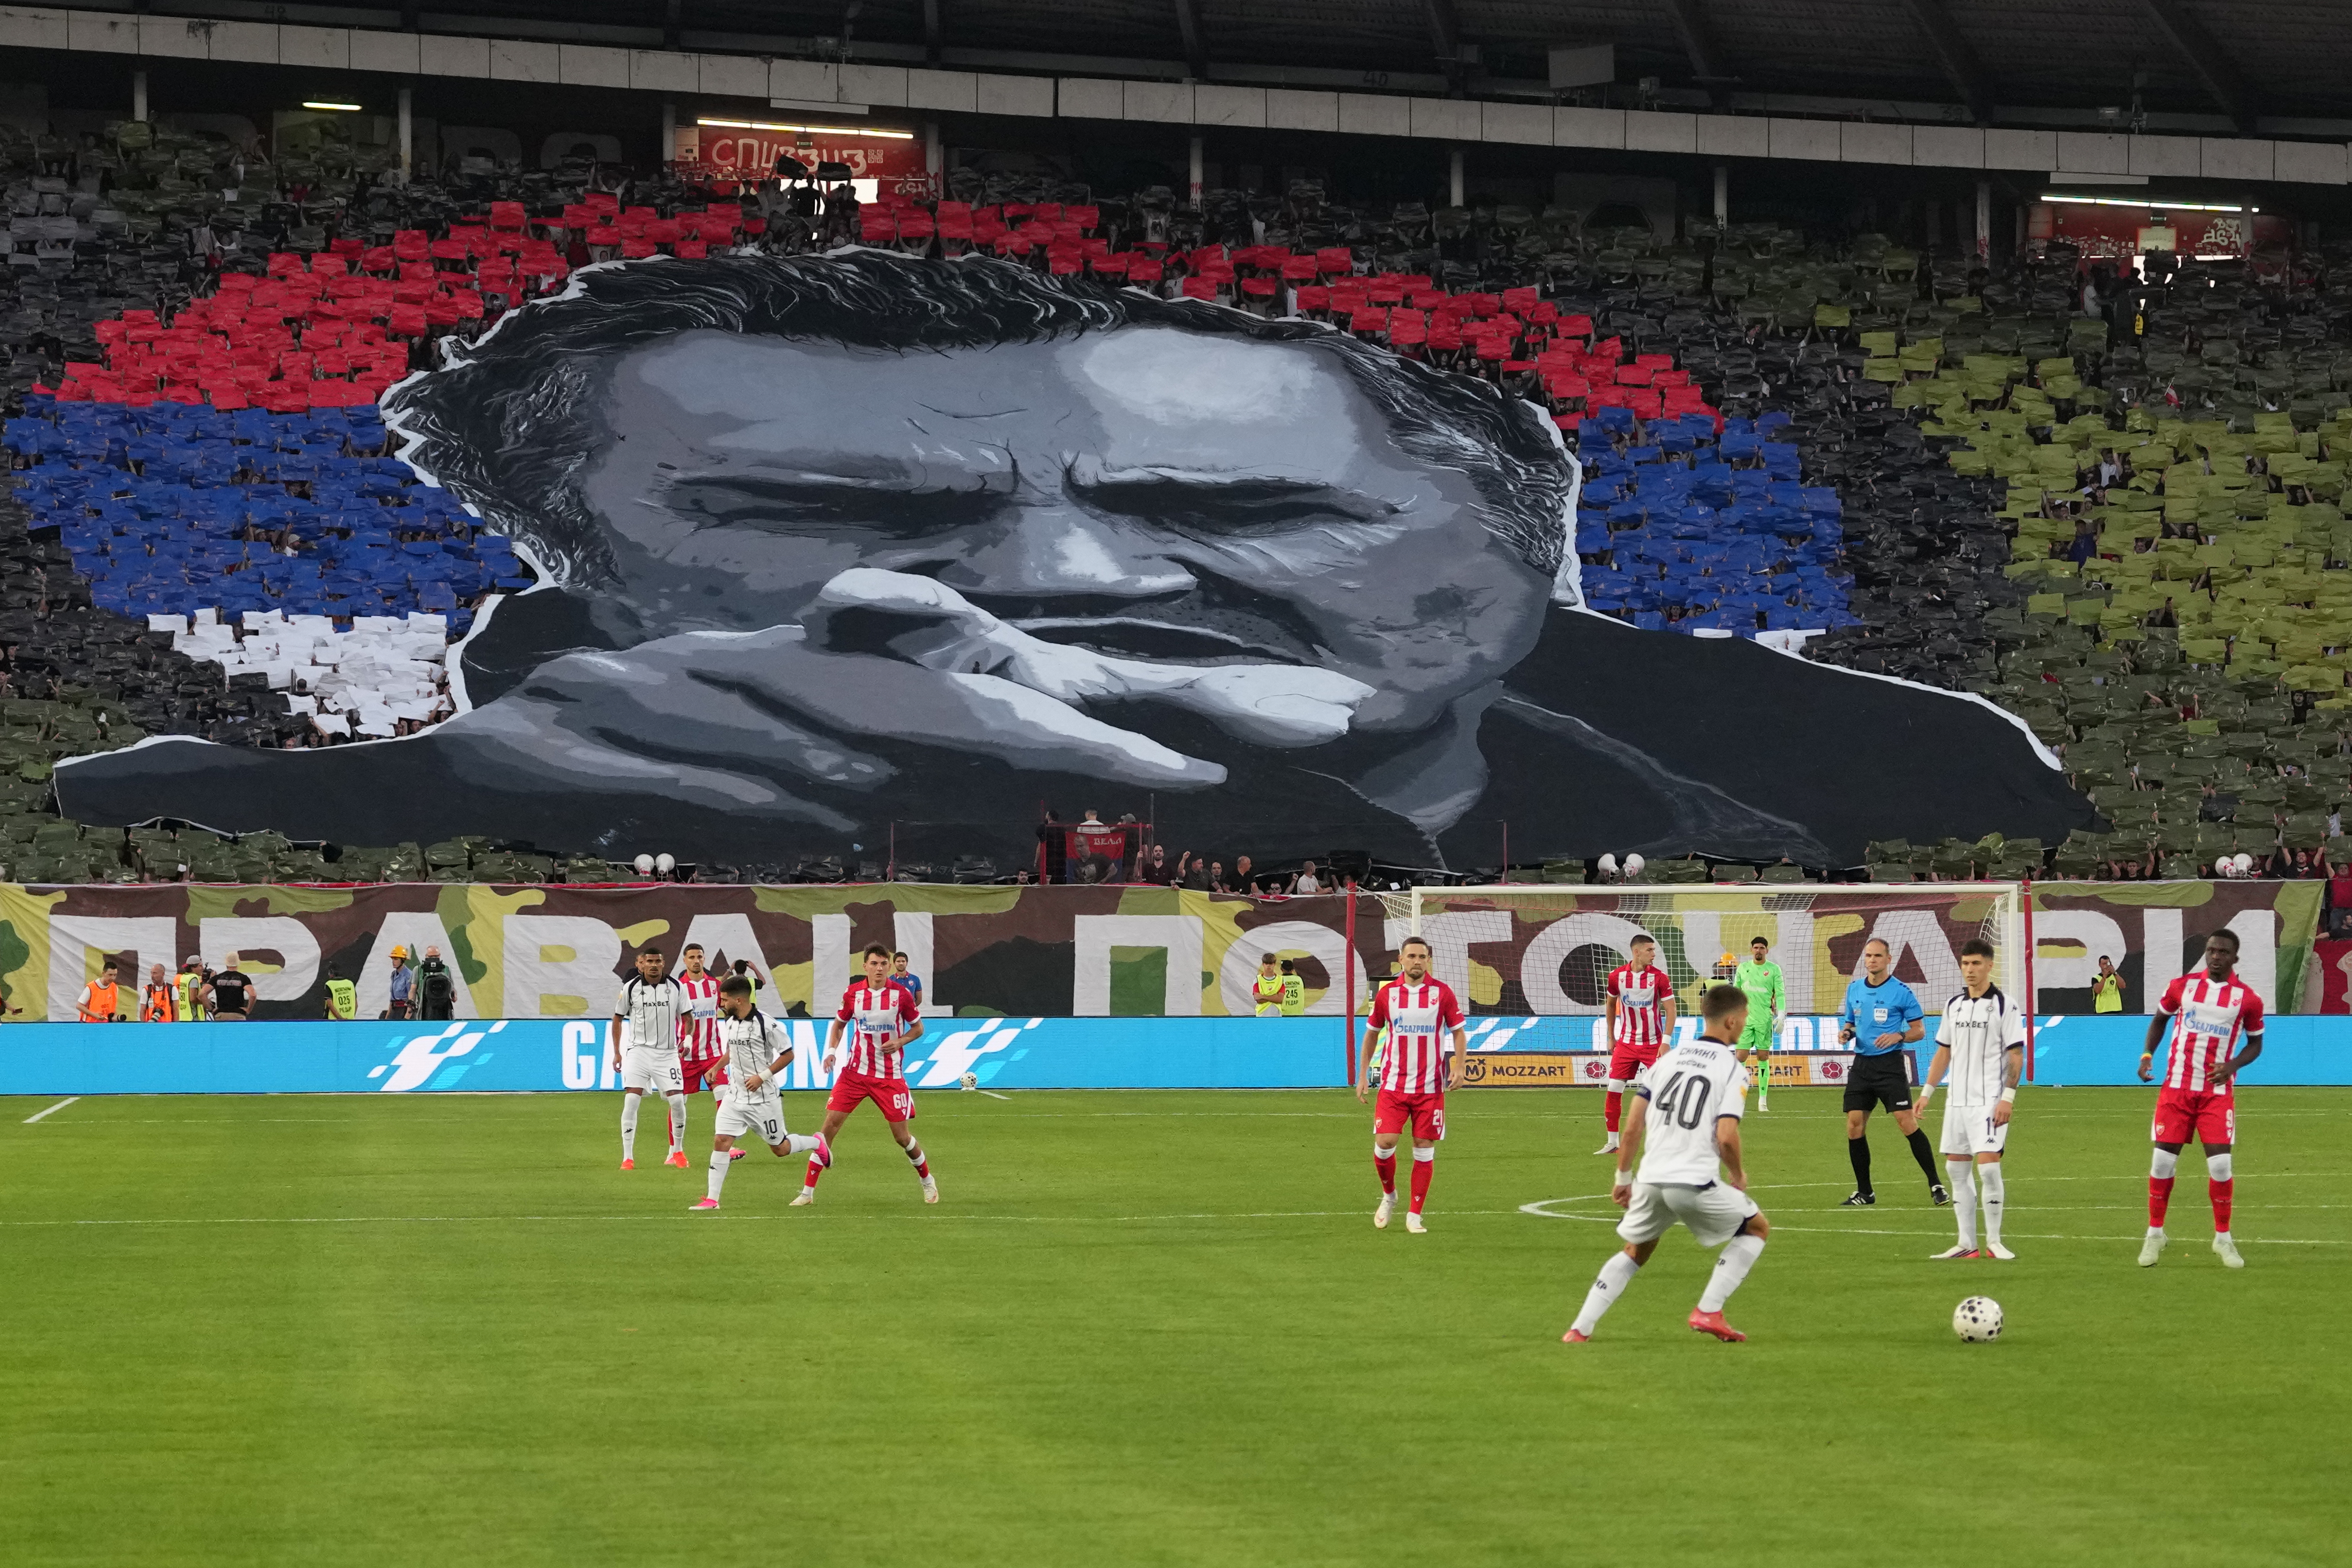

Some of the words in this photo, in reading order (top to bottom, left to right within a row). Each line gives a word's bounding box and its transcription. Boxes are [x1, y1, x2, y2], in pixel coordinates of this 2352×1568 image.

[48, 911, 953, 1022] ПРАВАЦ
[1072, 909, 2276, 1016] ПОТОЧАРИ
[338, 996, 350, 1005] 025
[1285, 989, 1298, 998] 245
[2196, 1023, 2230, 1036] GAZPROM
[670, 1068, 682, 1080] 89
[1492, 1066, 1566, 1076] MOZZART
[893, 1094, 906, 1109] 60
[1656, 1071, 1711, 1130] 40
[1432, 1109, 1442, 1125] 21
[2226, 1109, 2233, 1127] 9
[763, 1119, 777, 1134] 10
